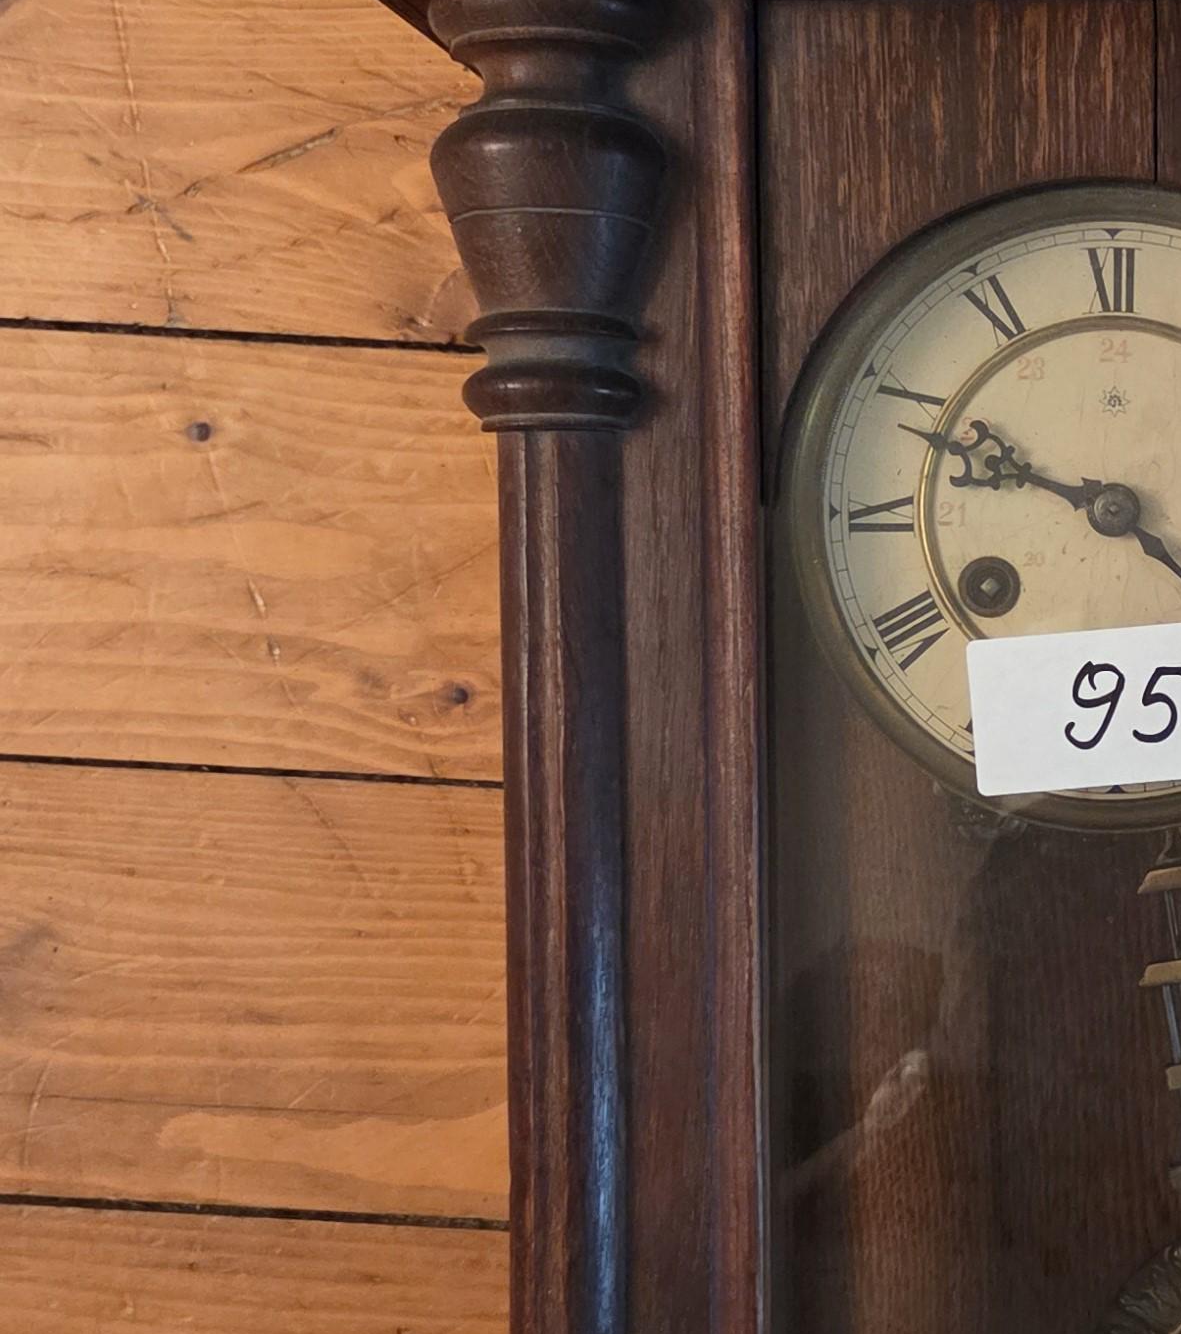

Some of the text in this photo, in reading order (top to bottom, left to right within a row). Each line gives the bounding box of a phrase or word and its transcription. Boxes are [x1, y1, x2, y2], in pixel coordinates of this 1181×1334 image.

[1082, 247, 1142, 315] XII
[956, 270, 1033, 349] XI
[1017, 356, 1046, 380] 23
[1099, 338, 1133, 364] 24
[872, 364, 951, 421] X
[848, 490, 917, 539] IX
[937, 501, 967, 527] 21
[1023, 550, 1046, 567] 20
[869, 581, 951, 677] VIII
